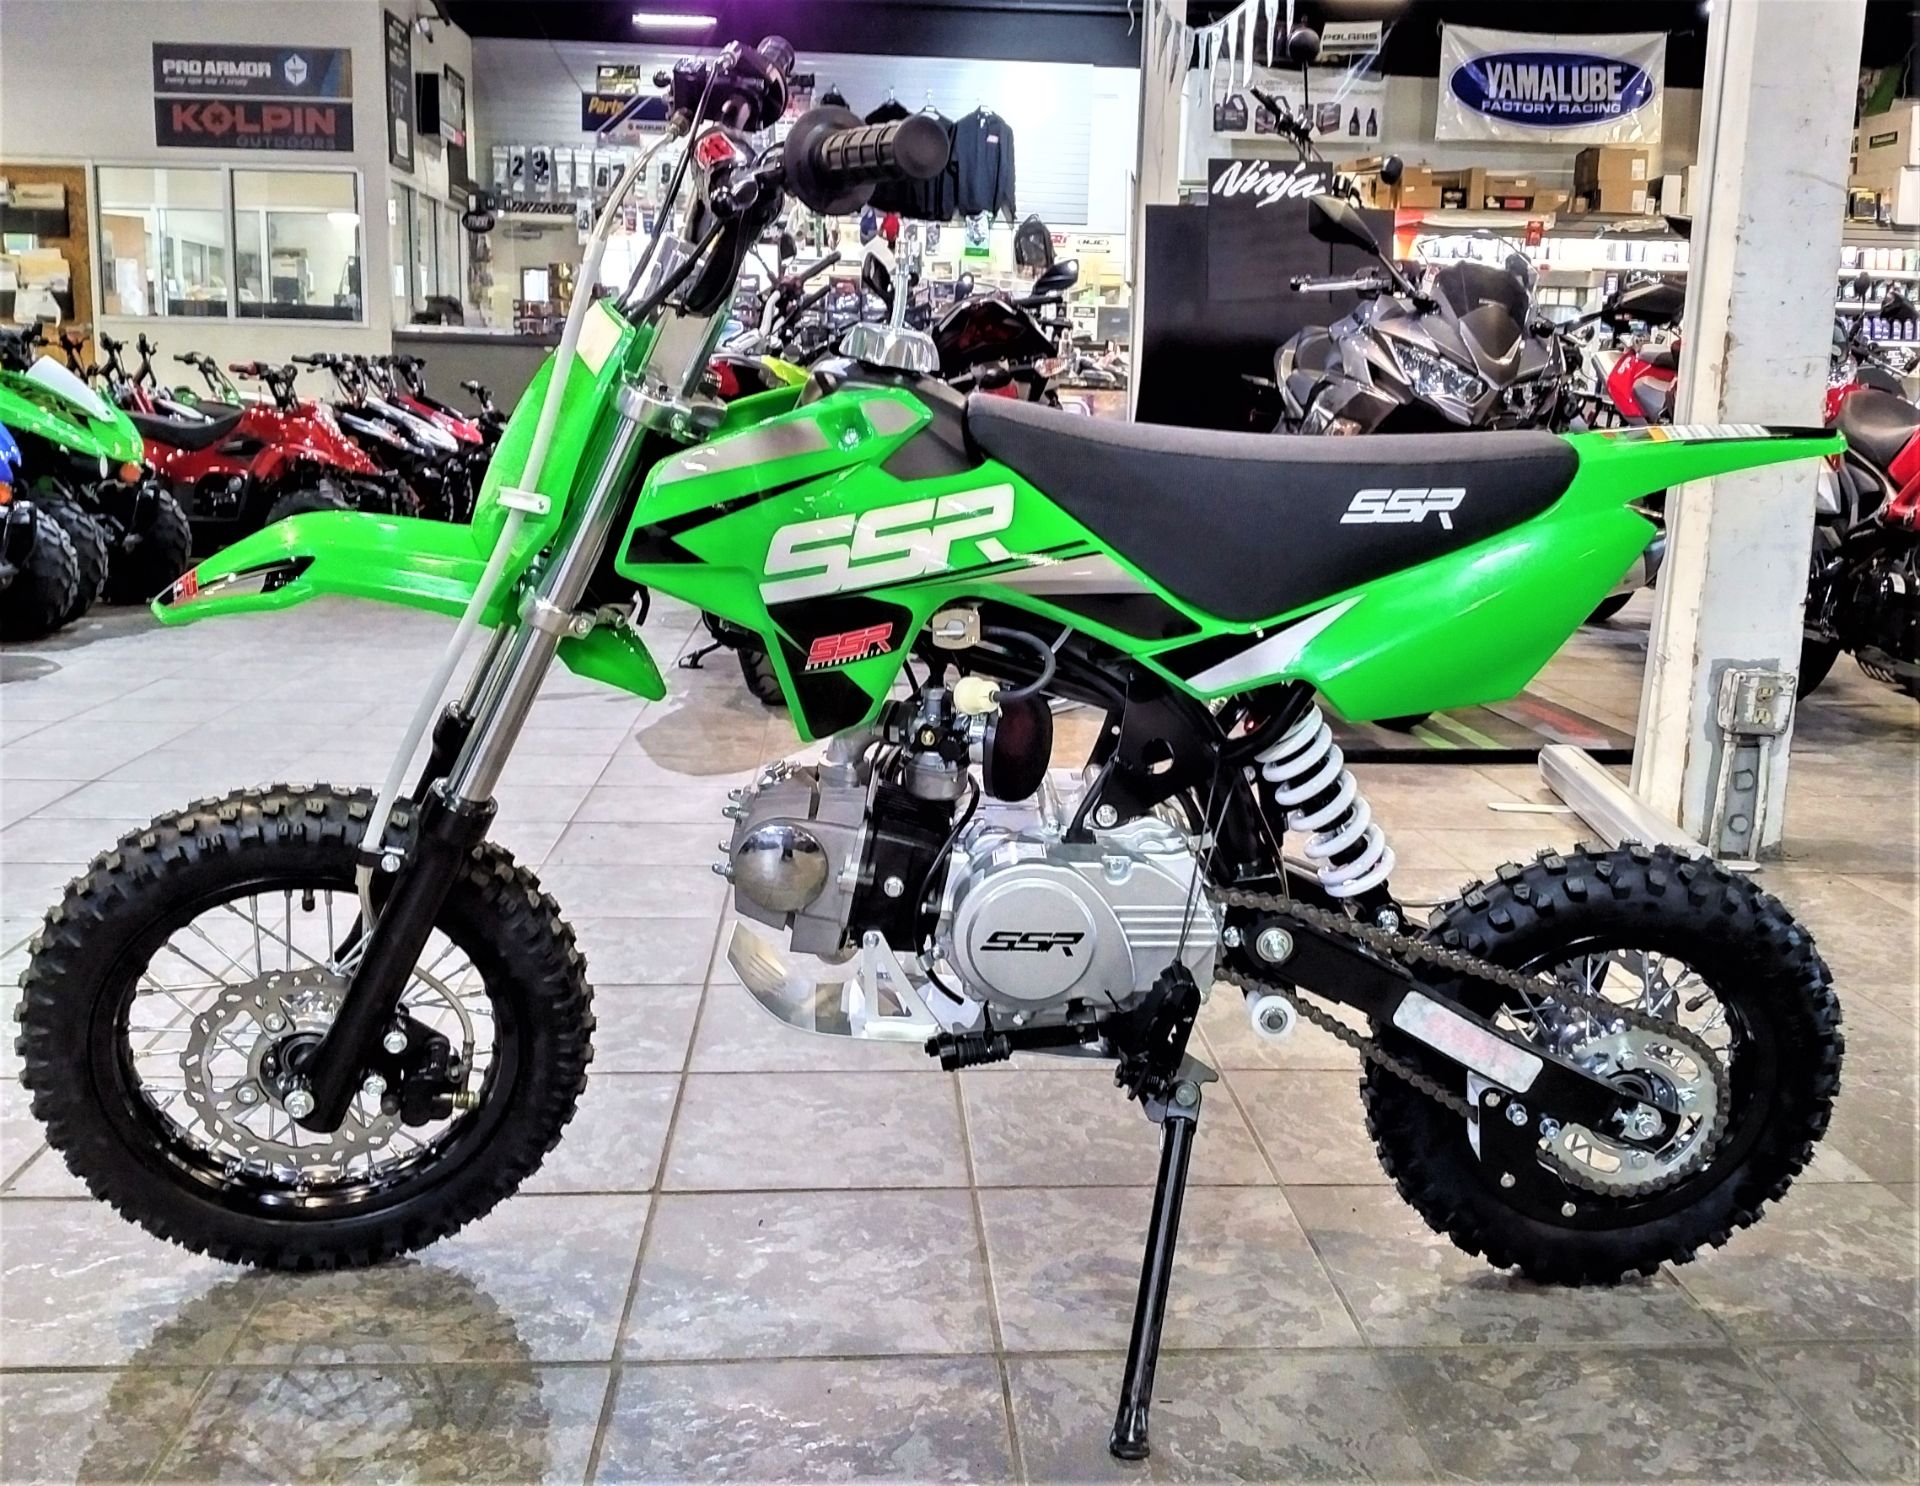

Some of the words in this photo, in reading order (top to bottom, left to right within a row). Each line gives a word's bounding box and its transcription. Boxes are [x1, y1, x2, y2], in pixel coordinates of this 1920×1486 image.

[1322, 31, 1378, 41] POLARIS
[162, 58, 201, 75] PRO
[203, 60, 271, 78] ARMOR
[1485, 61, 1622, 102] YAMALUBE
[172, 101, 335, 136] KOLPIN
[1482, 100, 1554, 114] FACTORY
[1558, 102, 1621, 114] RACING
[236, 134, 335, 150] OUTDOORS
[512, 155, 524, 176] 2
[1212, 159, 1326, 208] Ninja
[1339, 487, 1466, 530] SSR
[759, 484, 1015, 605] SSR
[807, 622, 893, 664] SSR
[980, 931, 1085, 957] SSR
